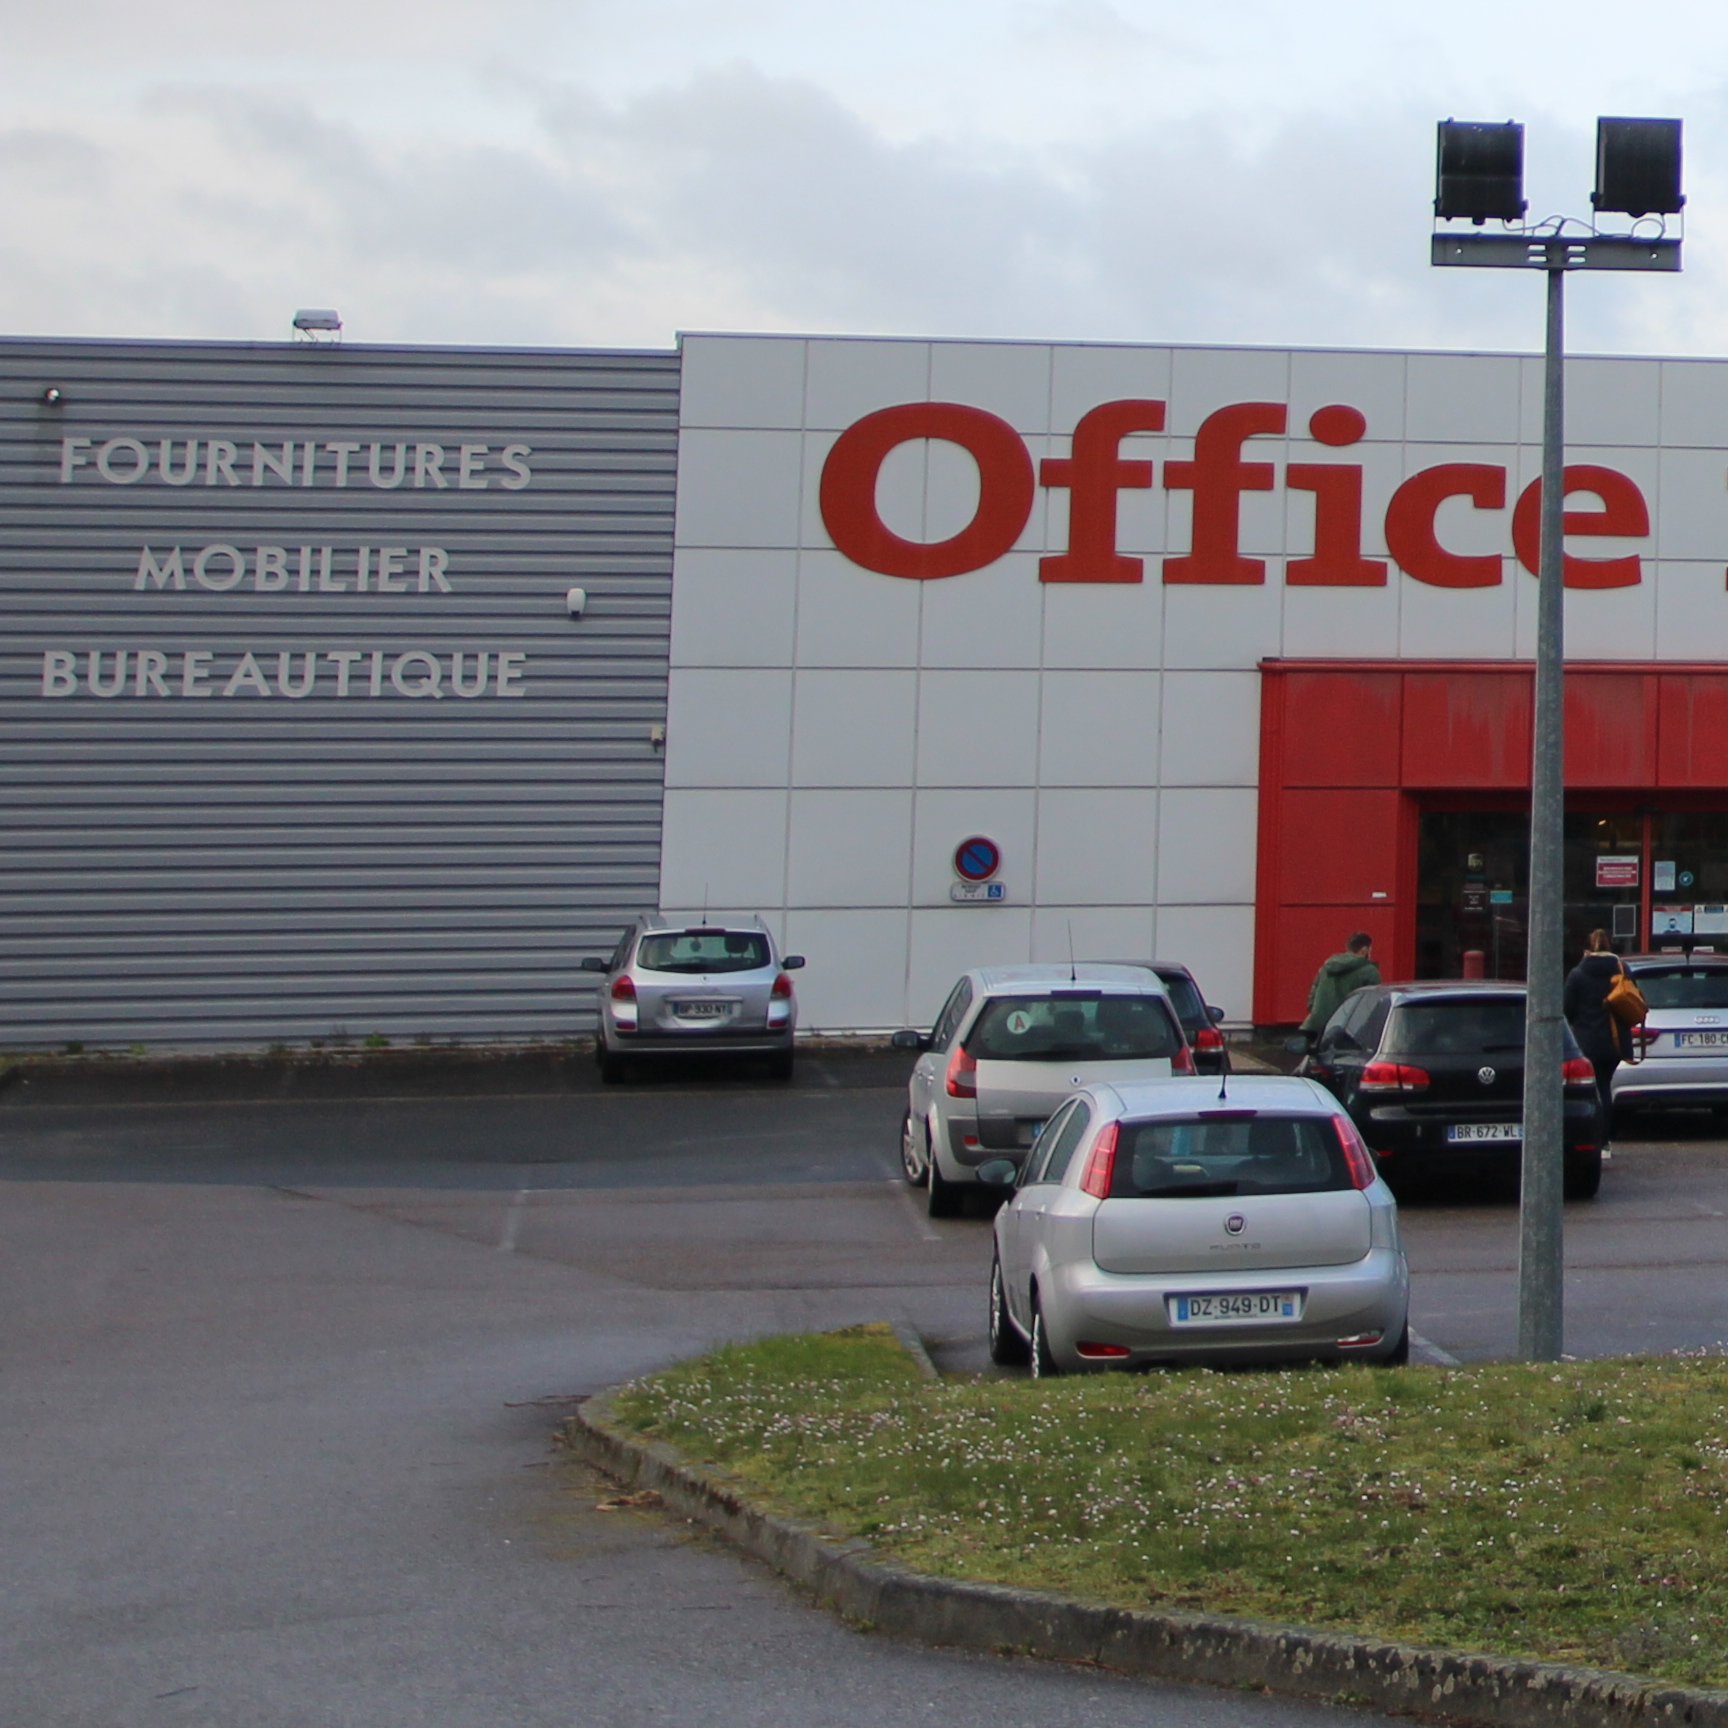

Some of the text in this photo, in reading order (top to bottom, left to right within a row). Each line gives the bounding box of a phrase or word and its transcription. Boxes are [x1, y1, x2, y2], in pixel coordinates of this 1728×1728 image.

[60, 437, 533, 490] FOURNITURES
[818, 399, 1650, 589] Office
[134, 544, 453, 594] MOBILIER
[41, 649, 528, 700] BUREAUTIQUE
[1190, 1295, 1280, 1317] DZ-949-DT
